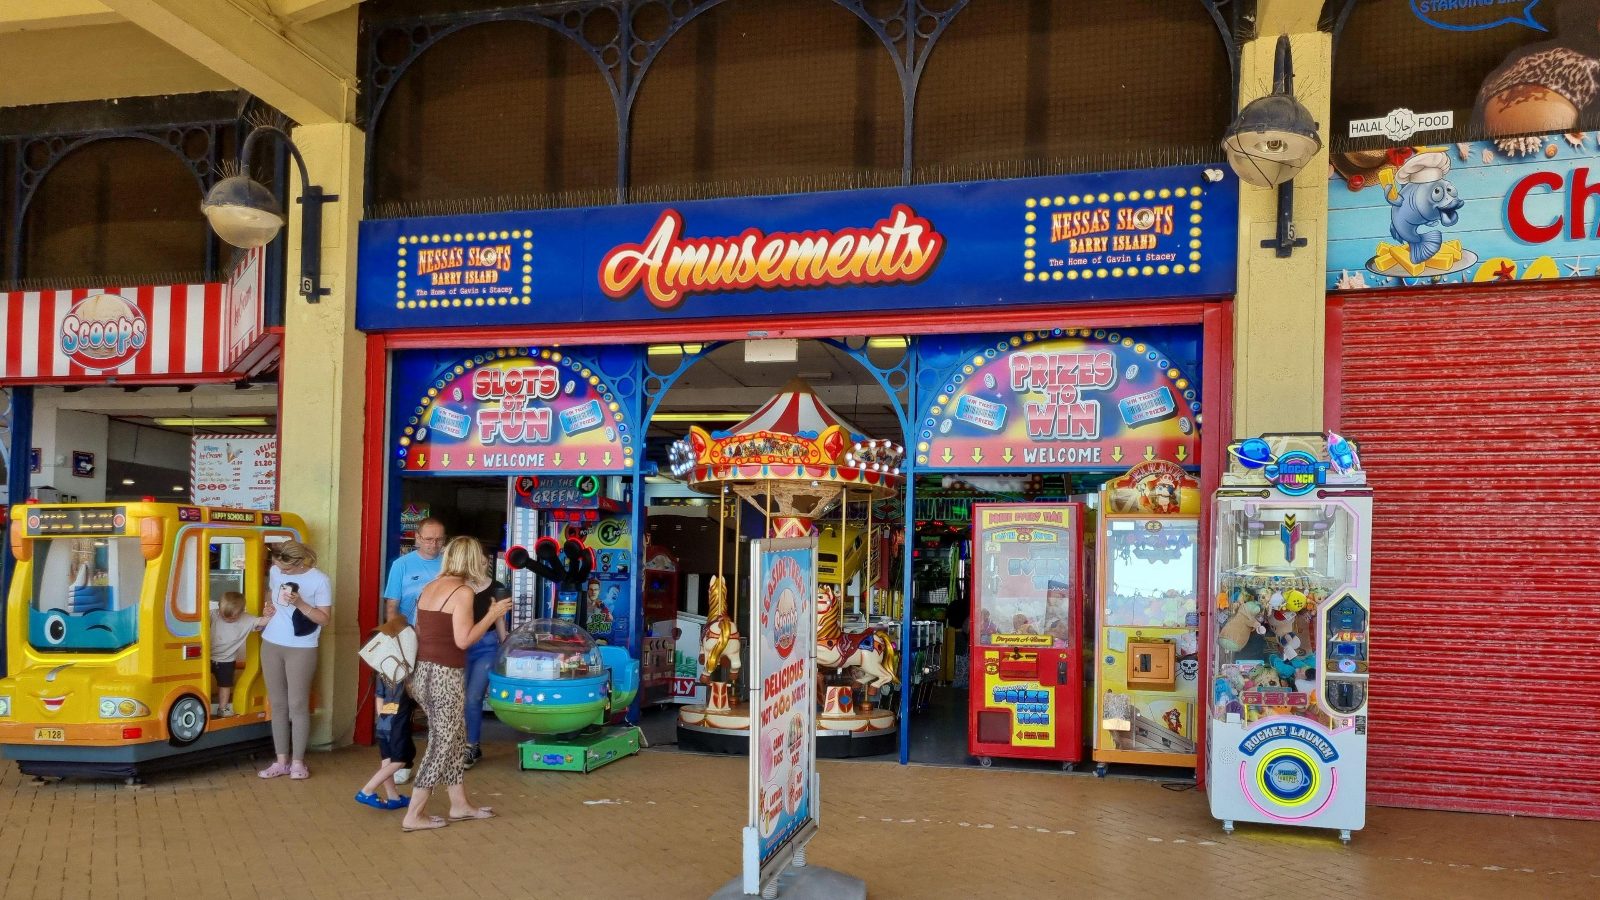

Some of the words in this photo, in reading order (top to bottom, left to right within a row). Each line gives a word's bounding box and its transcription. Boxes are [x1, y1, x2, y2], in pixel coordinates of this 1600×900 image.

[1351, 121, 1383, 134] HALAL
[1418, 115, 1449, 128] FOOD
[1051, 207, 1110, 243] NESSA'S
[1116, 204, 1173, 236] SLOTS
[1069, 236, 1108, 254] BARRY
[1113, 234, 1157, 252] ISLAND
[417, 248, 464, 275] NESSA'S
[468, 245, 511, 272] SLOTS
[601, 208, 937, 304] Amusements
[1049, 259, 1063, 267] The
[1068, 257, 1087, 265] Home
[1092, 256, 1102, 264] of
[1106, 255, 1131, 264] Gavin
[1146, 252, 1177, 262] Stacey
[431, 271, 462, 286] BARRY
[465, 269, 498, 284] ISLAND
[430, 288, 445, 296] Home
[449, 287, 457, 295] of
[489, 286, 513, 294] Stacey
[62, 314, 147, 357] Scoops
[1012, 352, 1114, 388] PRIZES
[474, 367, 558, 398] SLOTS
[502, 394, 526, 411] OF
[1046, 384, 1077, 405] TO
[478, 409, 551, 442] FUN
[1026, 403, 1097, 437] WIN
[483, 453, 545, 467] WELCOME
[1023, 447, 1102, 464] WELCOME
[1280, 474, 1314, 484] LAUNCH
[532, 489, 580, 503] GREEN!
[211, 512, 227, 520] HAPPY
[227, 512, 245, 521] SCHOOL
[764, 658, 805, 702] DELICIOUS
[994, 689, 1049, 704] PRIZE
[1017, 704, 1049, 713] EVERY
[1017, 713, 1049, 725] TIME
[38, 730, 62, 739] A-128
[1243, 725, 1287, 753] ROCKET
[1290, 725, 1335, 760] LAUNCH
